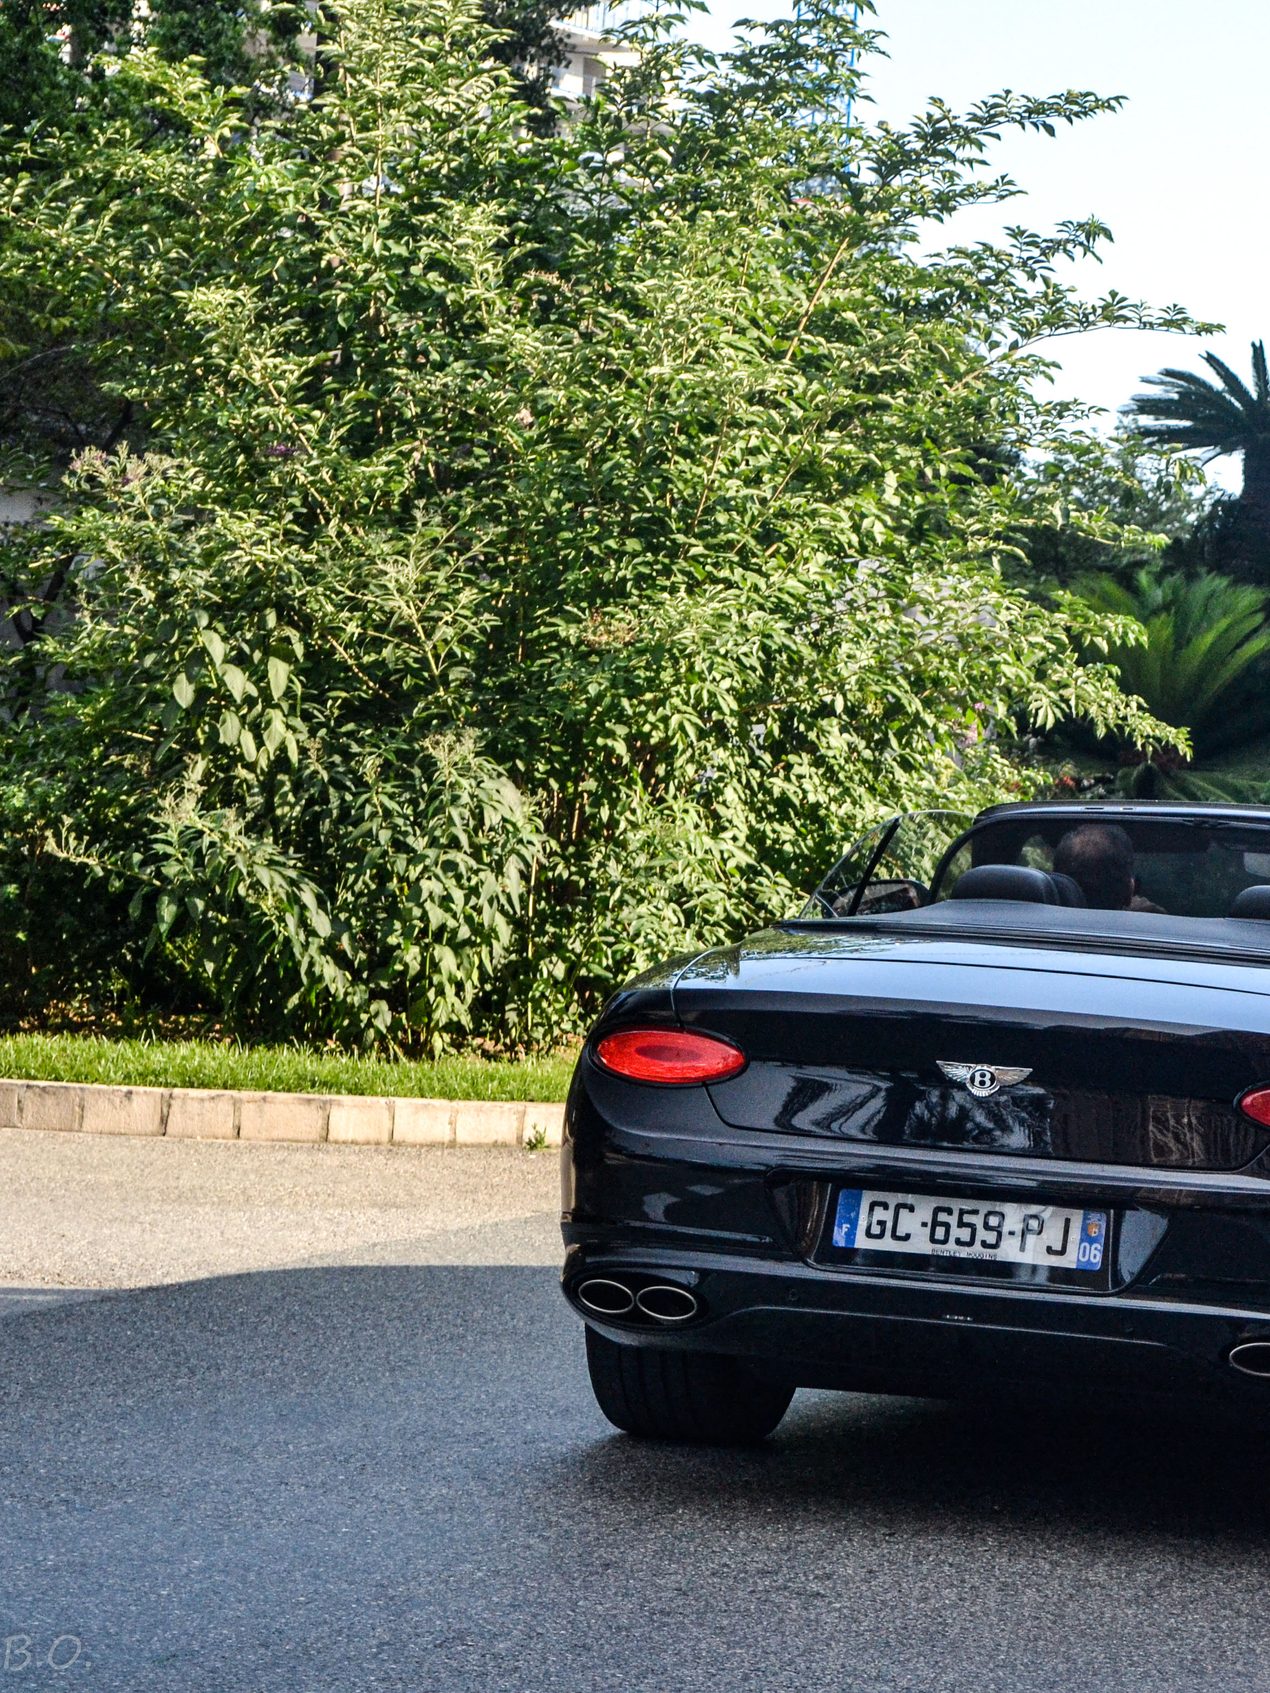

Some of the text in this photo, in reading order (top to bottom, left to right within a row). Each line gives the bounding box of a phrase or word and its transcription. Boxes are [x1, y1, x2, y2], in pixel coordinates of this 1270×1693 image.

[973, 1070, 992, 1088] B
[841, 1223, 851, 1236] F
[864, 1200, 1072, 1256] GC-659-PJ
[931, 1248, 998, 1262] BENTLEY MOUGINS
[1078, 1242, 1101, 1264] 06
